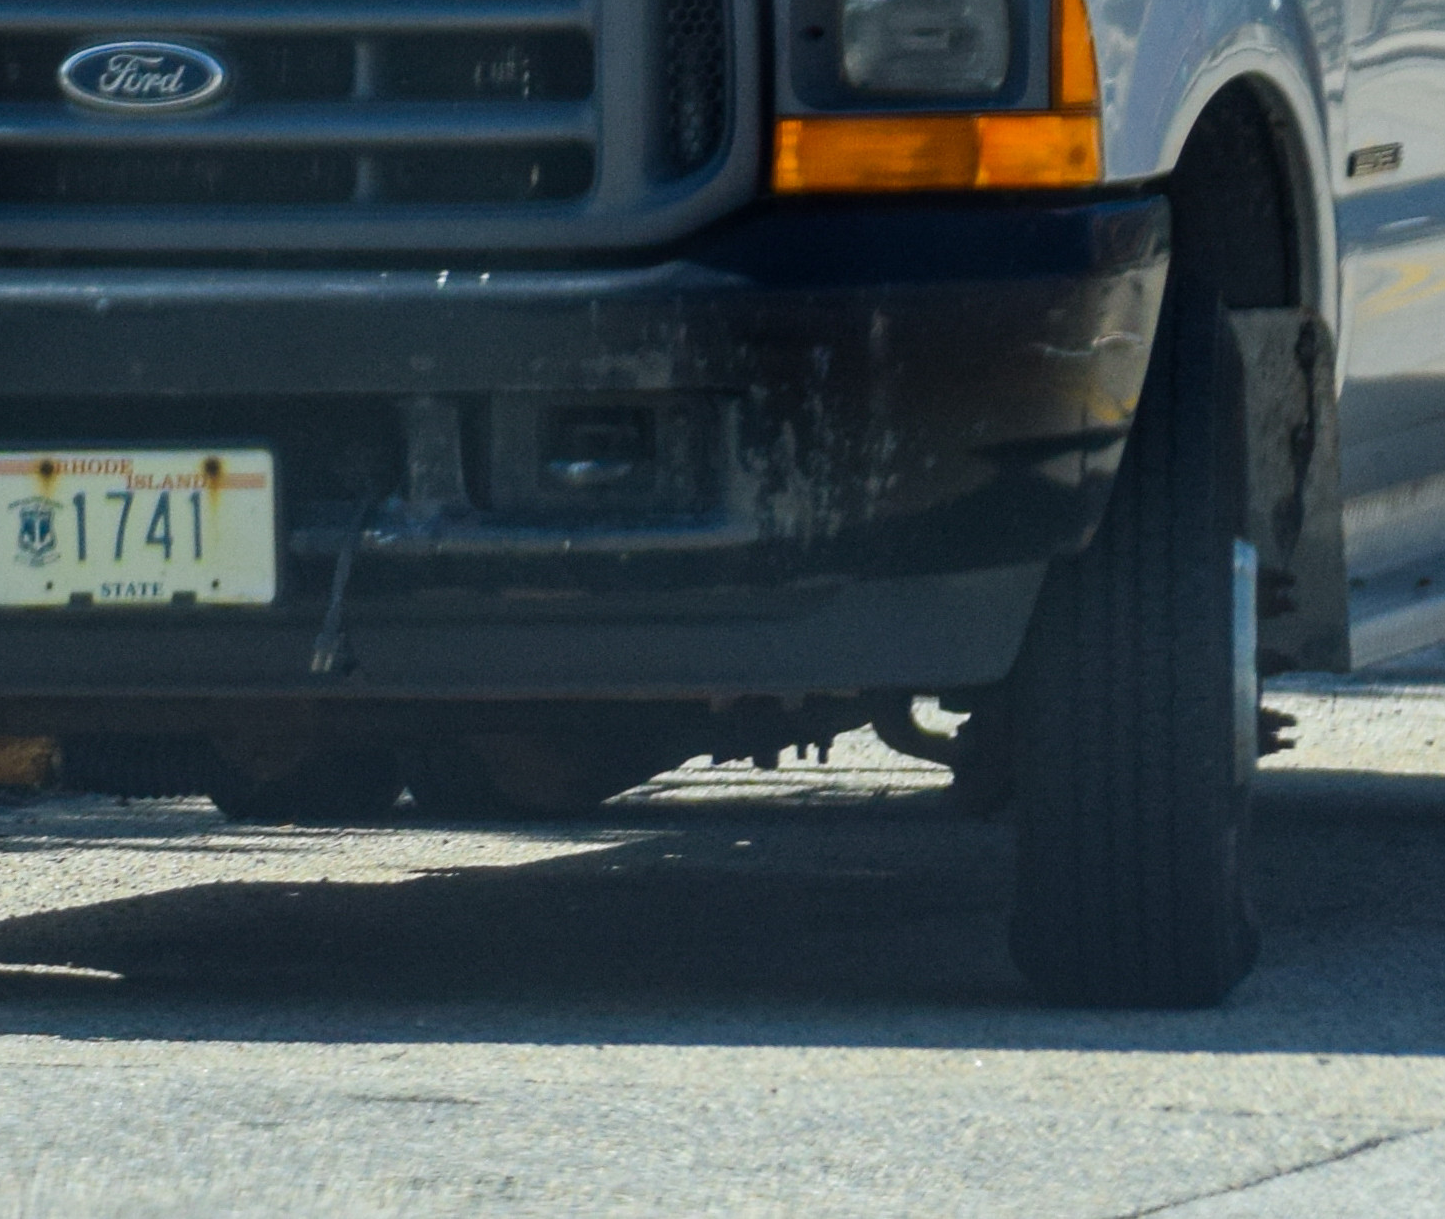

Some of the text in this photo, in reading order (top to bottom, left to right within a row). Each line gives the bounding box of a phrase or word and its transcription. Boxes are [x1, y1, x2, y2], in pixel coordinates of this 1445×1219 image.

[99, 54, 185, 93] Ford
[55, 458, 133, 474] RHODE
[126, 473, 205, 489] ISLAND
[72, 490, 203, 561] 1741
[101, 581, 164, 597] STATE
